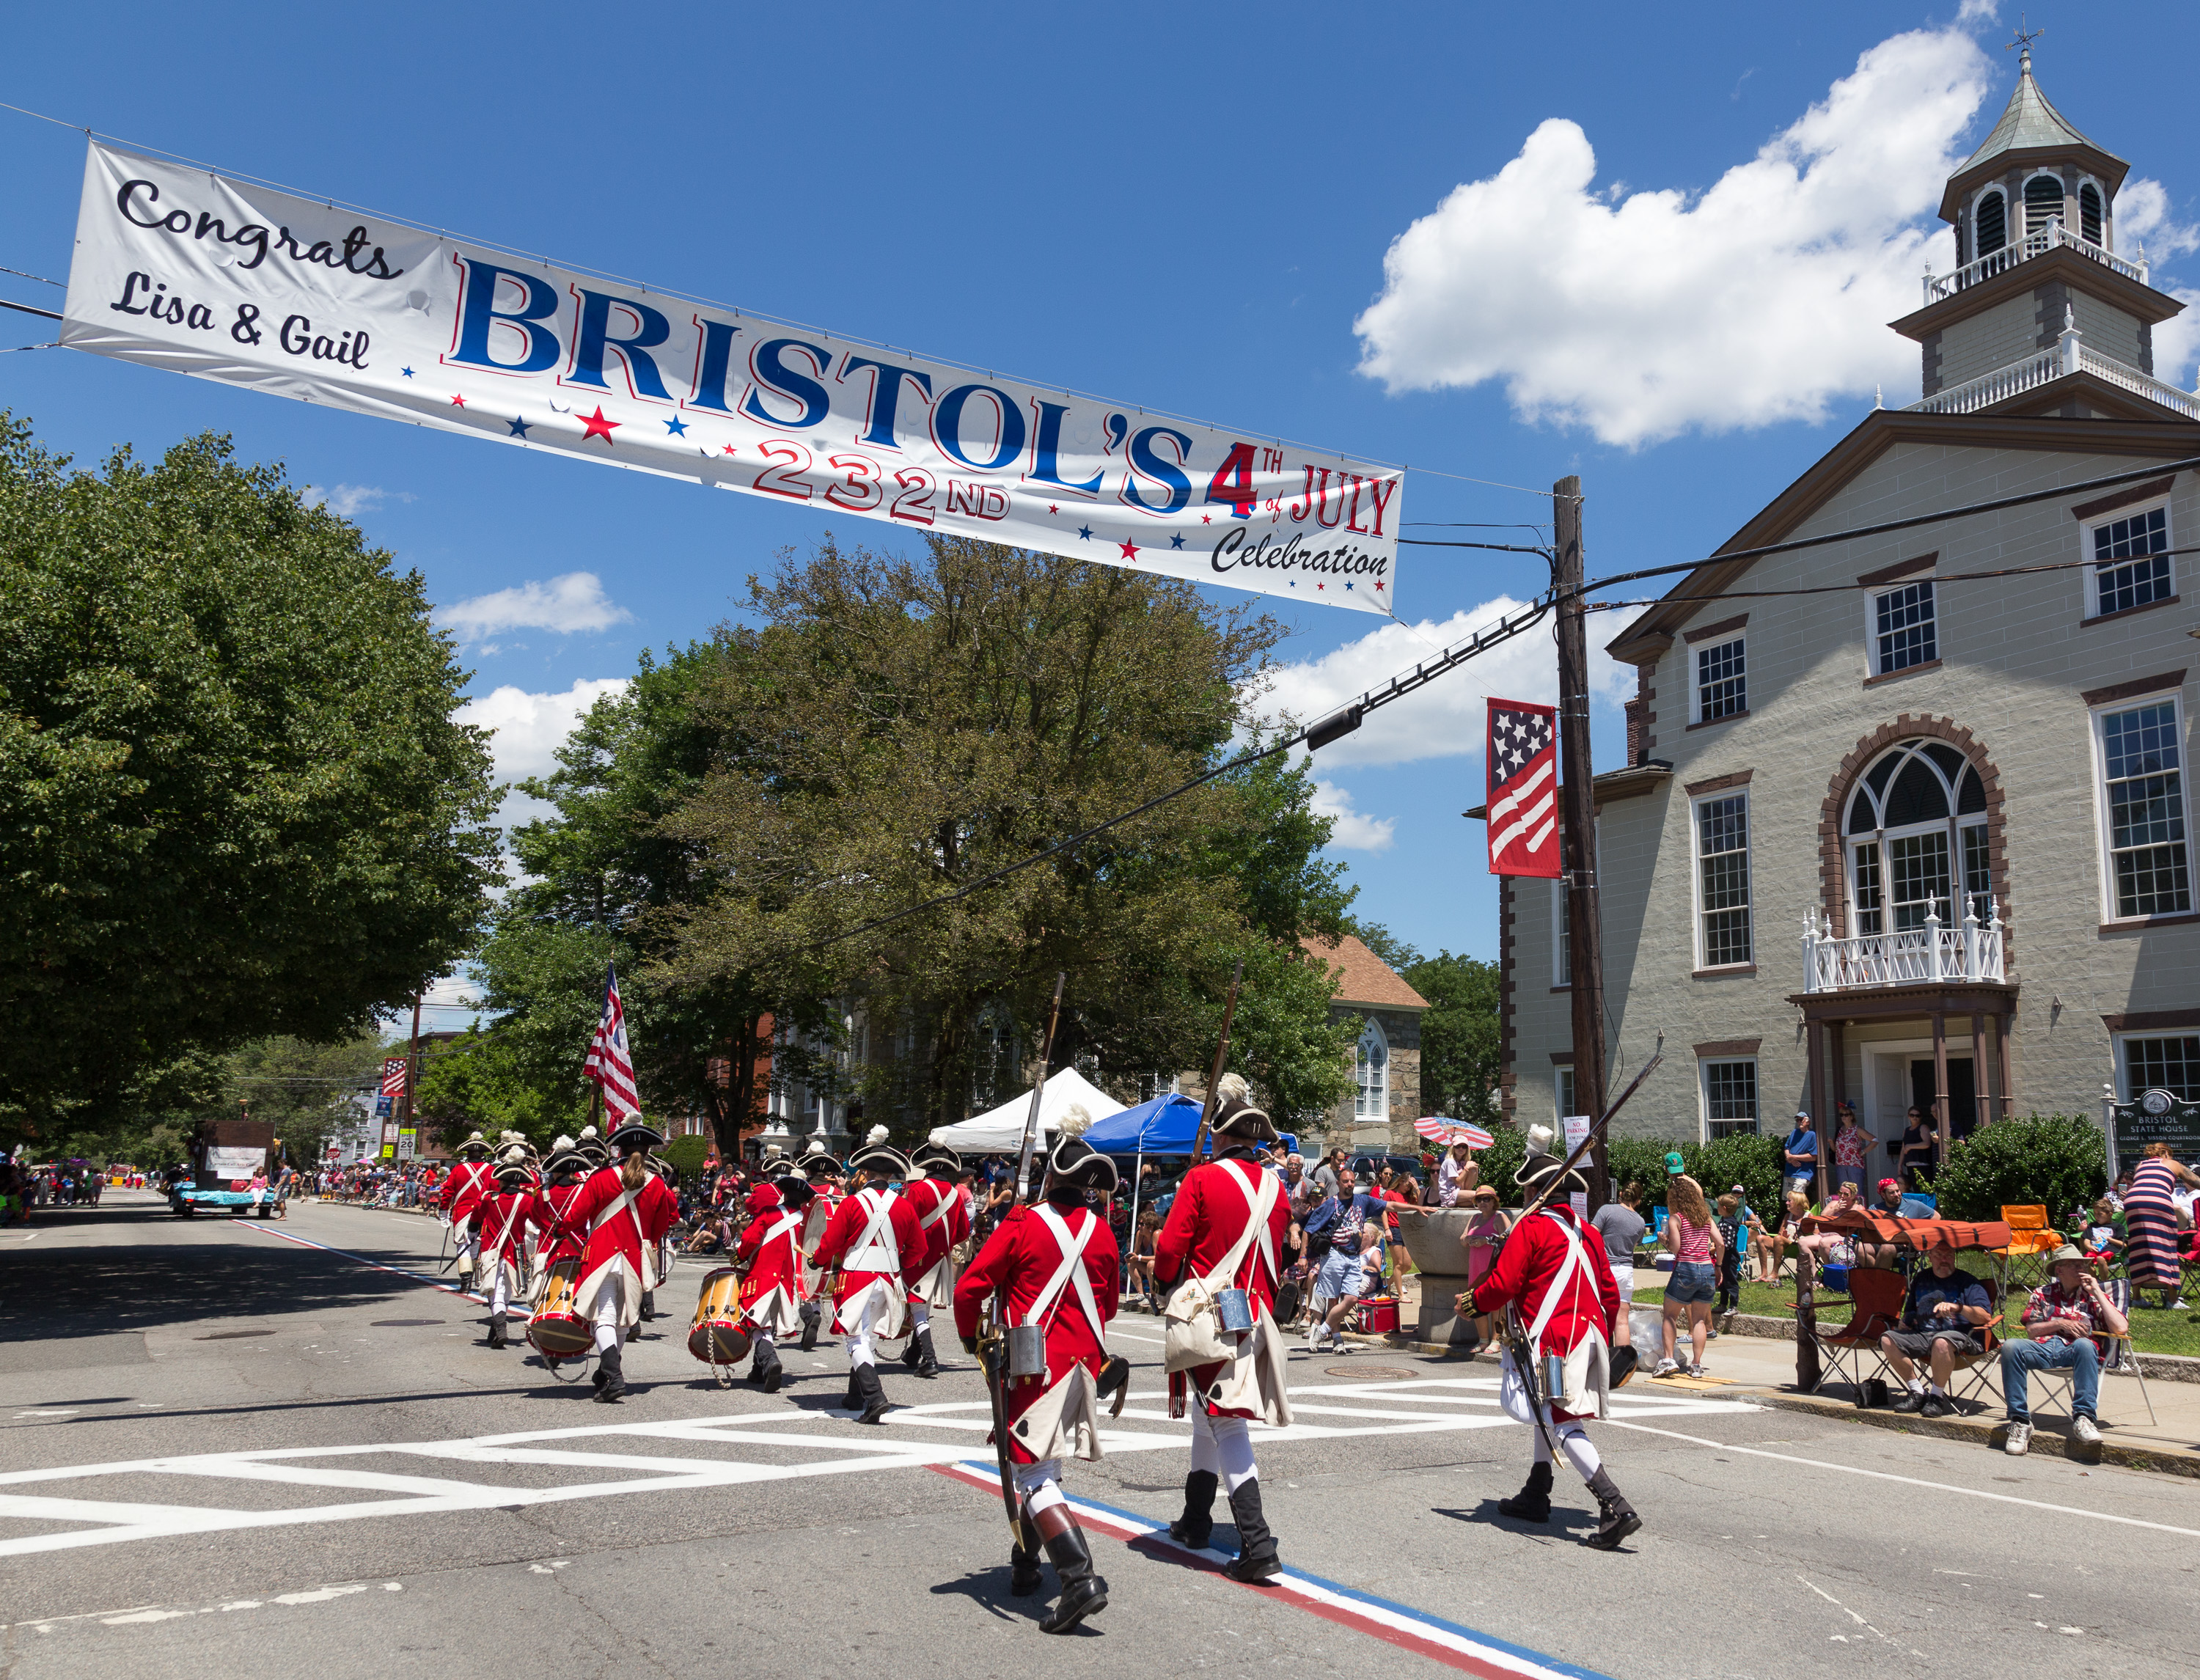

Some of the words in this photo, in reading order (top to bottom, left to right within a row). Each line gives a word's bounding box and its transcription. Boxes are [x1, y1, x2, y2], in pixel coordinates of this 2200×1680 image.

[117, 179, 404, 280] Congrats
[110, 271, 216, 330] Lisa
[231, 304, 263, 347] &
[280, 314, 370, 370] Gail
[440, 252, 1194, 519] BRISTOL'S
[752, 439, 1011, 527] 232ND
[1265, 489, 1284, 524] of
[1288, 463, 1398, 539] JULY
[1211, 526, 1387, 576] Celebration
